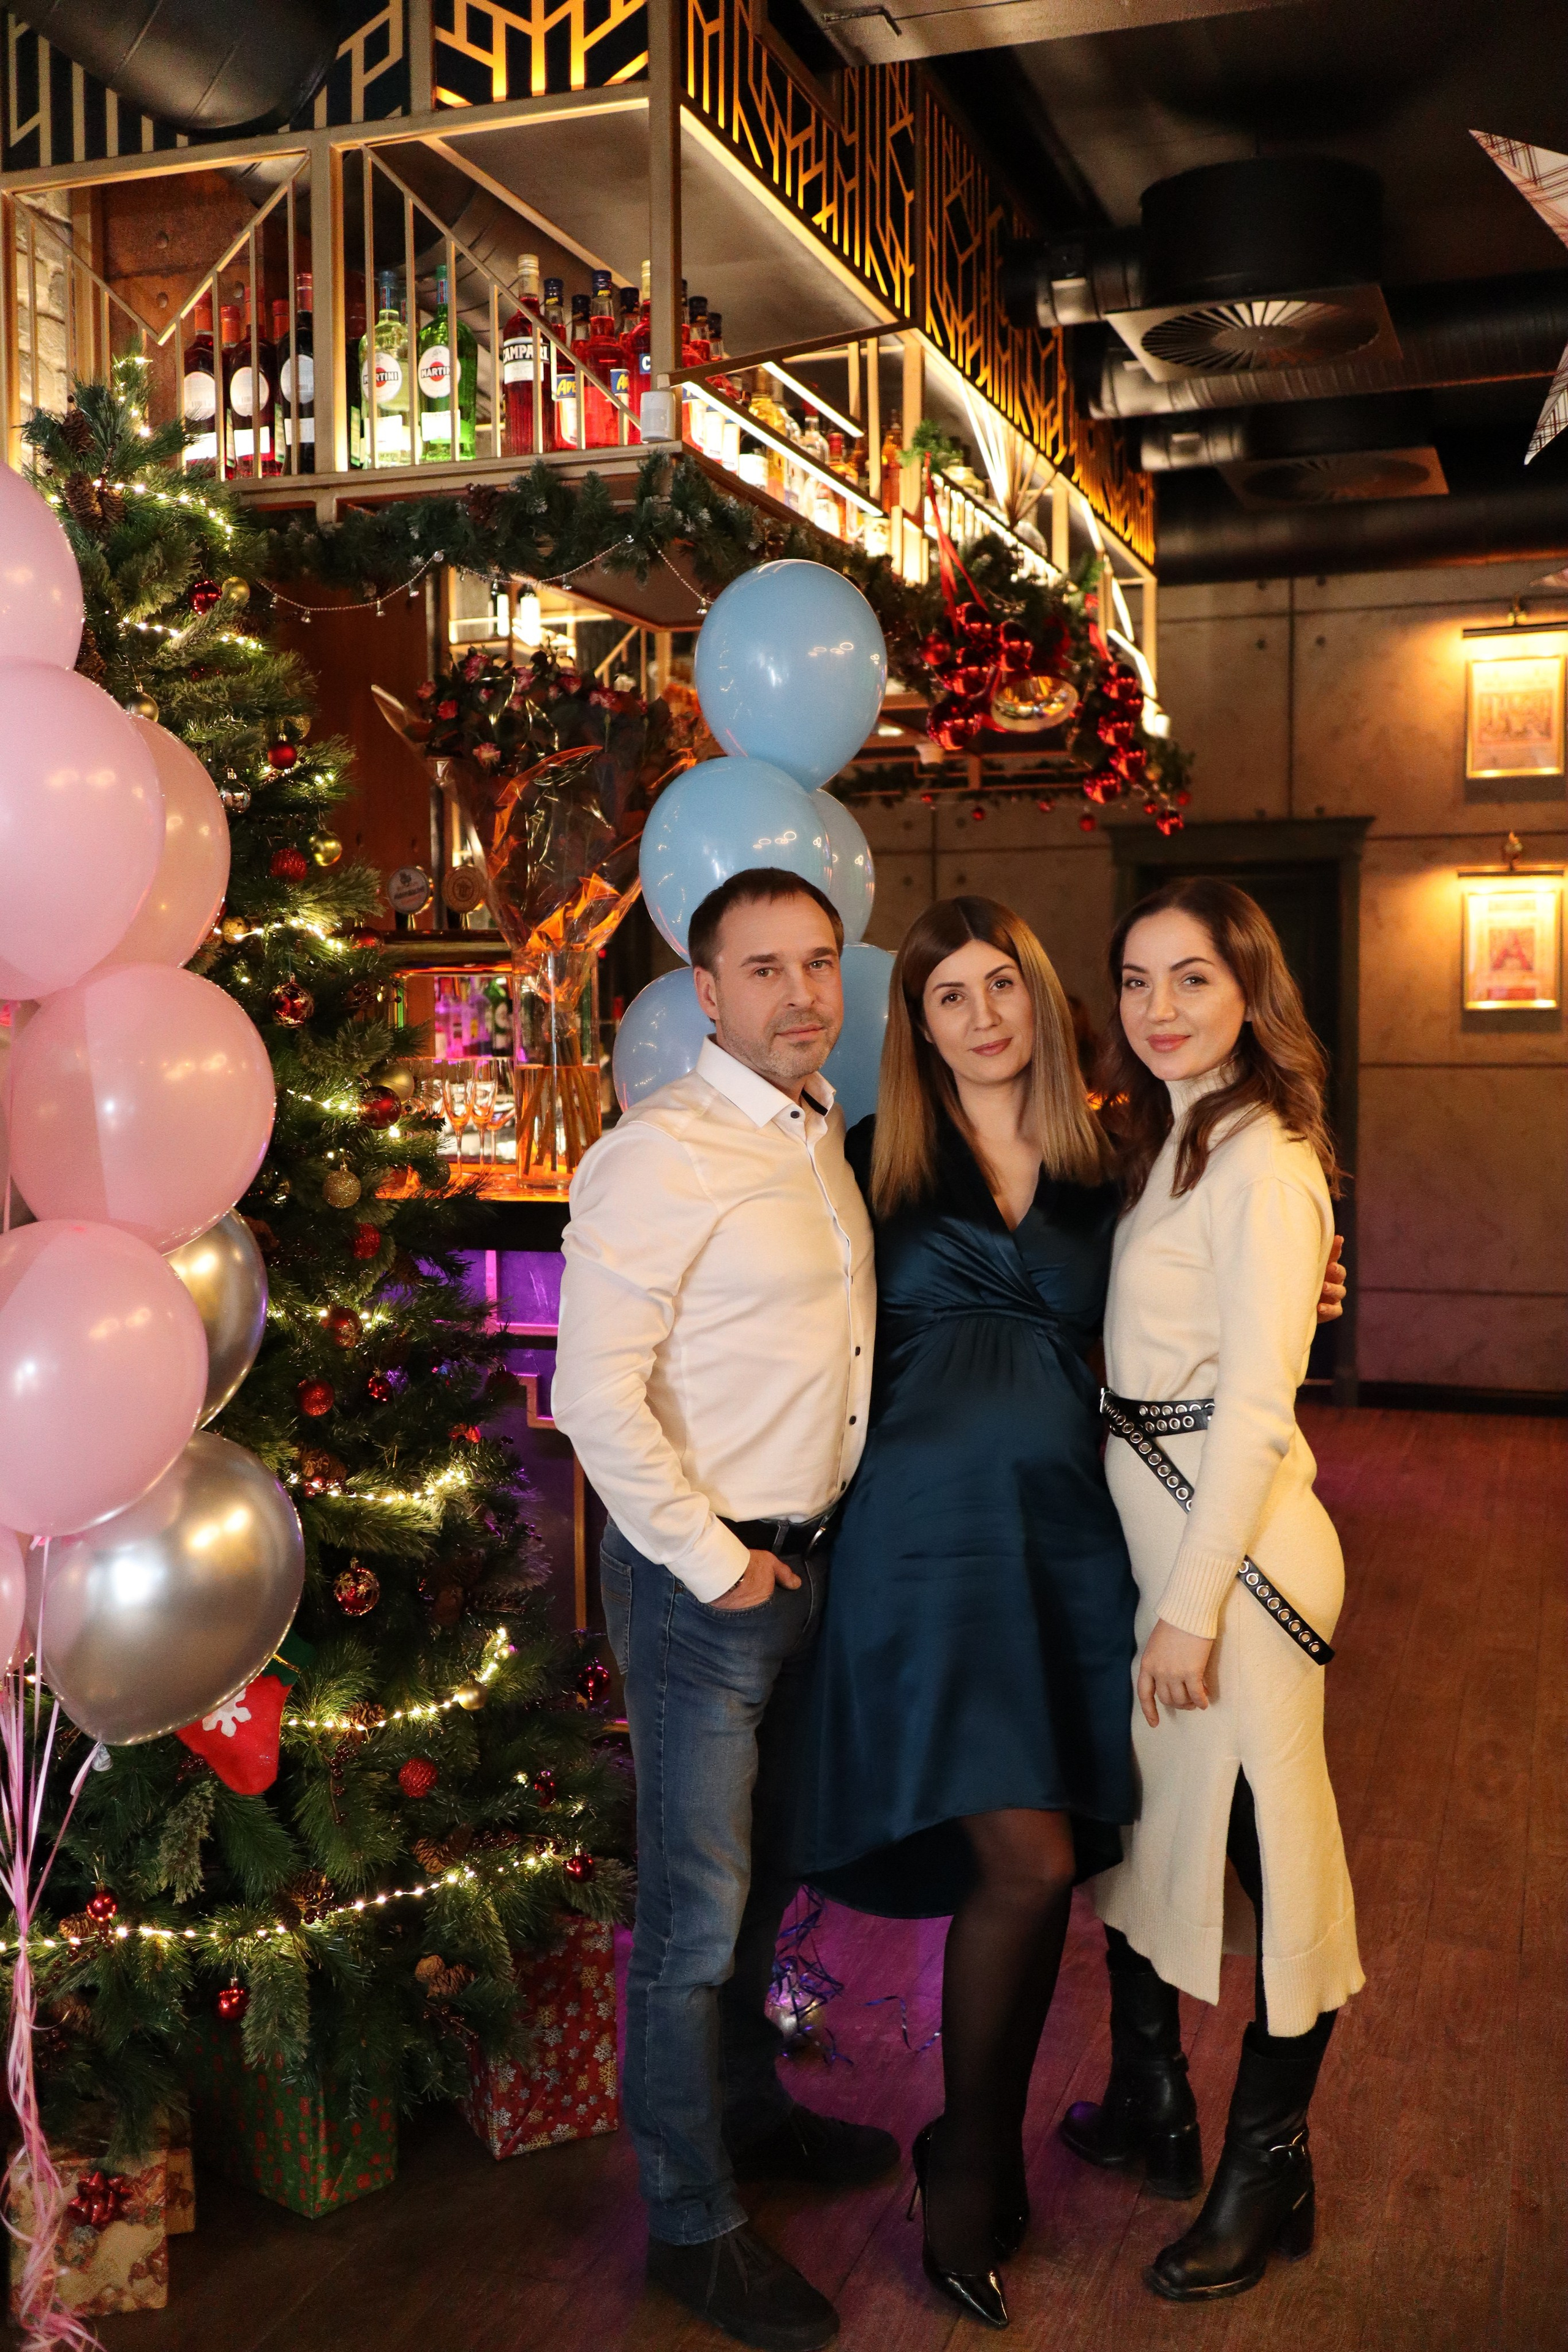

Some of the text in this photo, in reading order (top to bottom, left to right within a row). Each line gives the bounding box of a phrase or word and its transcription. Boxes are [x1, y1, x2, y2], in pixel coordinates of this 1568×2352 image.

[363, 371, 399, 385] MRTINI
[421, 366, 450, 379] MARTI
[556, 379, 576, 396] APE
